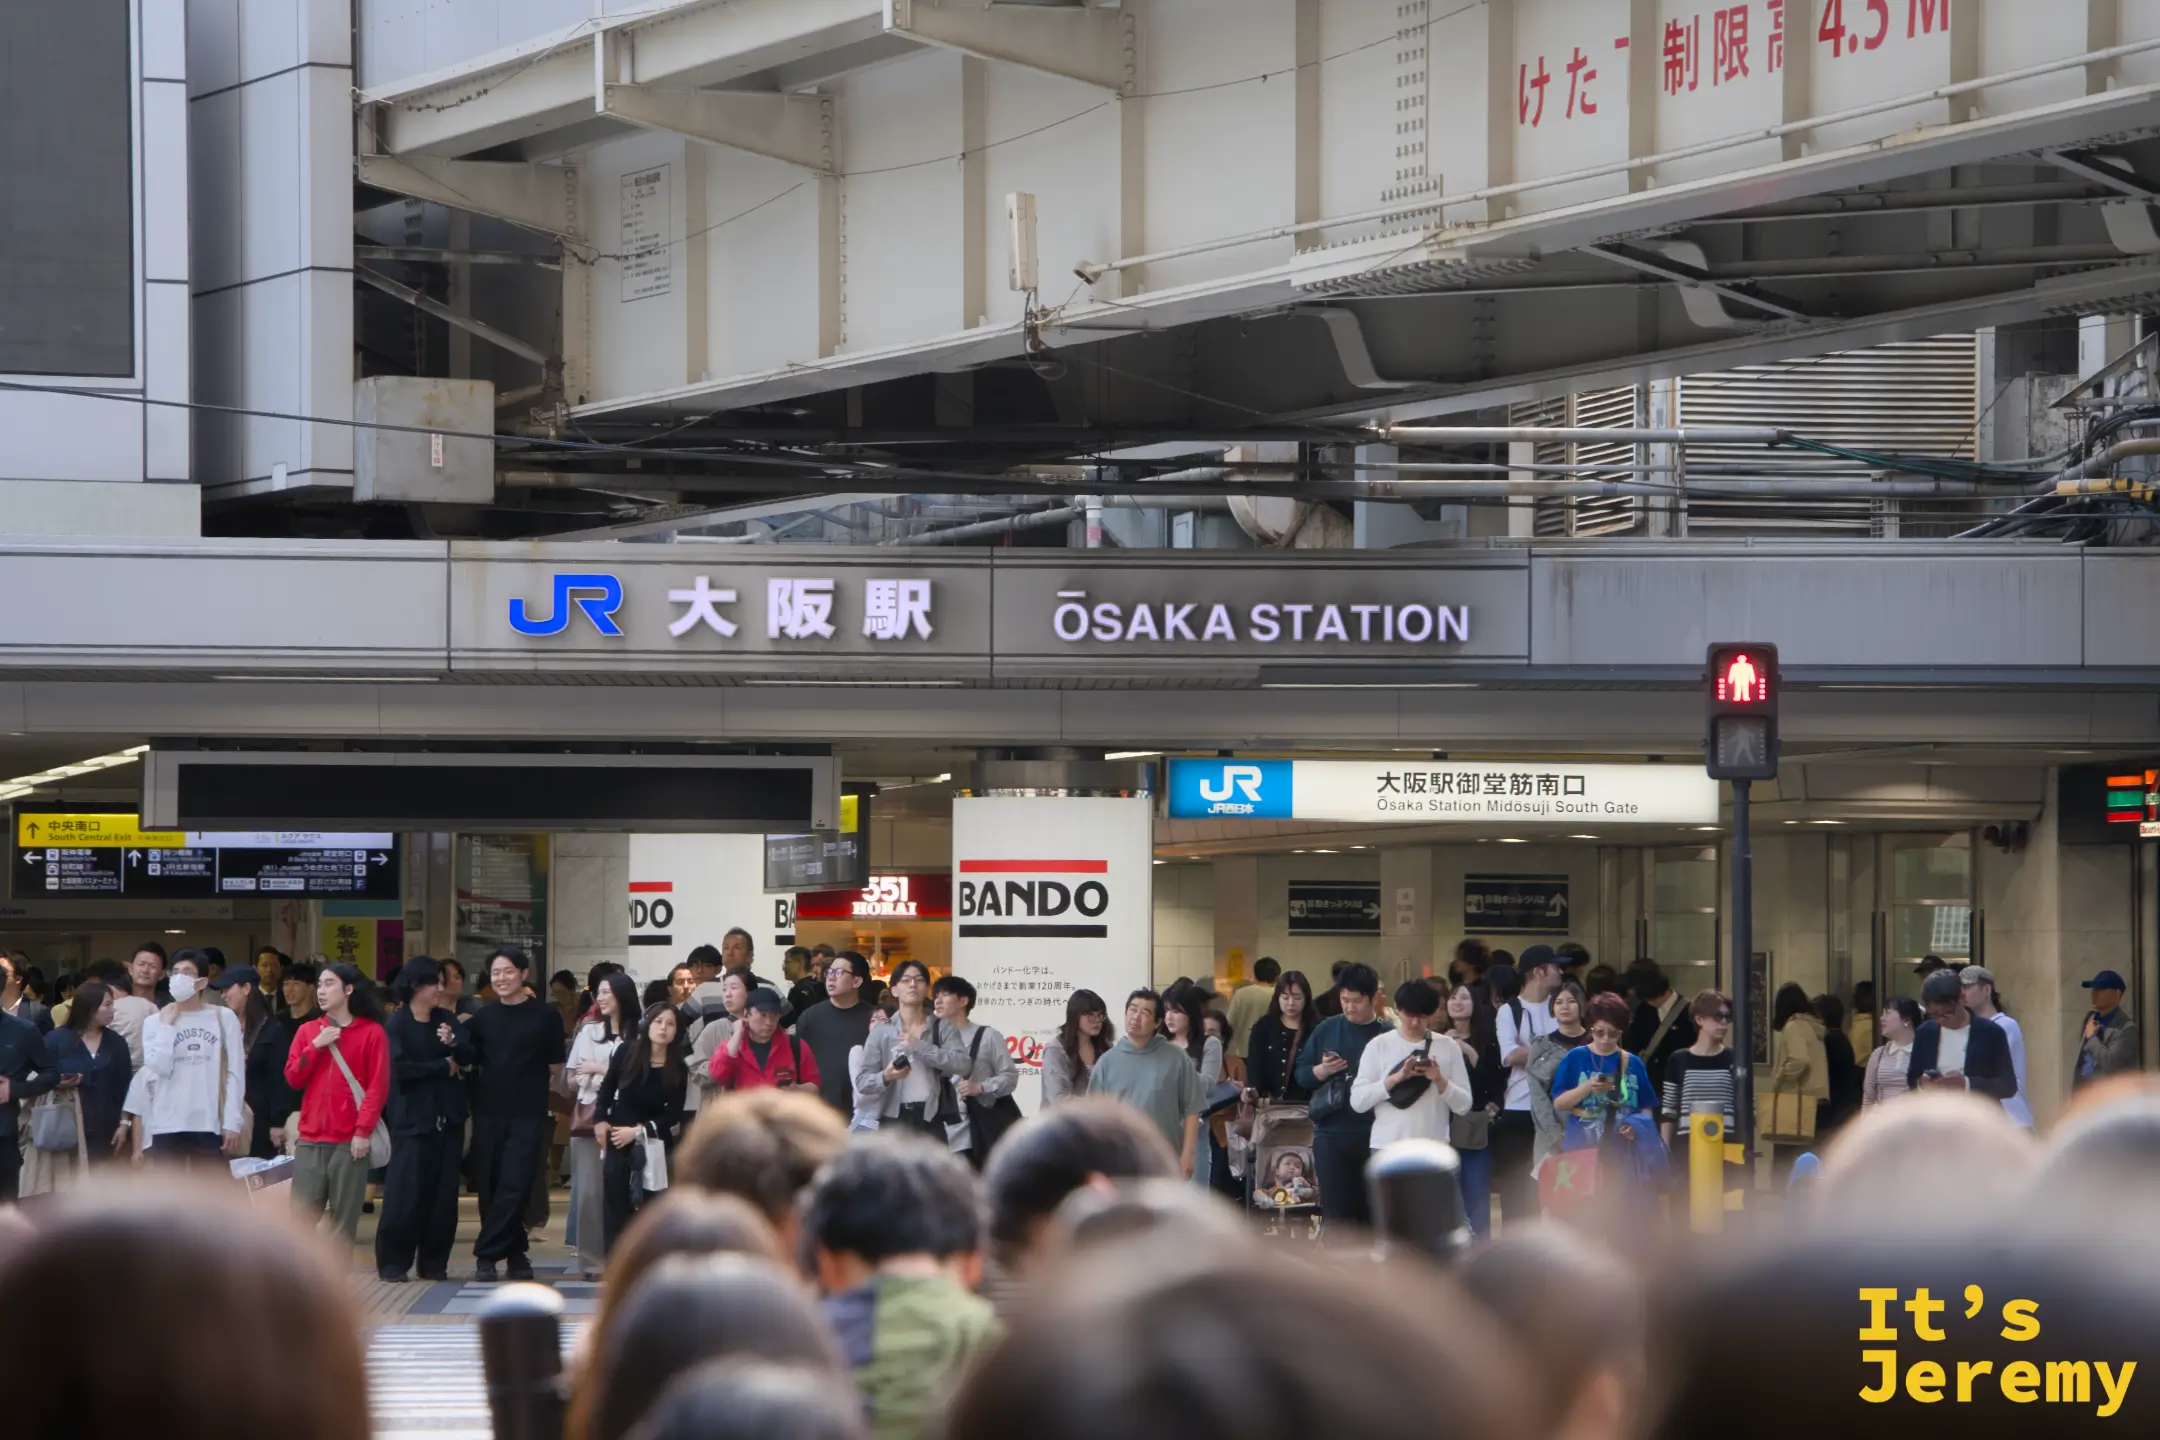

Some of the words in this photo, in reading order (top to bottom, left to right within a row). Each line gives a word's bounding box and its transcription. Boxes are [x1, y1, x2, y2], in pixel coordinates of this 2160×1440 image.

[509, 574, 624, 636] JR
[667, 576, 934, 641] 大阪駅
[1053, 590, 1236, 642] ŌSAKA
[1249, 603, 1468, 642] STATION
[1200, 765, 1262, 802] JR
[1376, 771, 1586, 796] 大阪駅御堂筋南口
[1377, 796, 1423, 811] Ōsaka
[1429, 799, 1481, 812] Station
[1487, 801, 1550, 815] Midōsuji
[1555, 801, 1599, 813] South
[1604, 801, 1639, 814] Gate
[48, 821, 100, 831] 中央南口
[48, 833, 76, 841] South
[79, 833, 112, 841] Central
[114, 833, 132, 841] Exit
[861, 876, 908, 902] 551
[959, 881, 1109, 917] BANDO
[852, 902, 917, 915] HORAI
